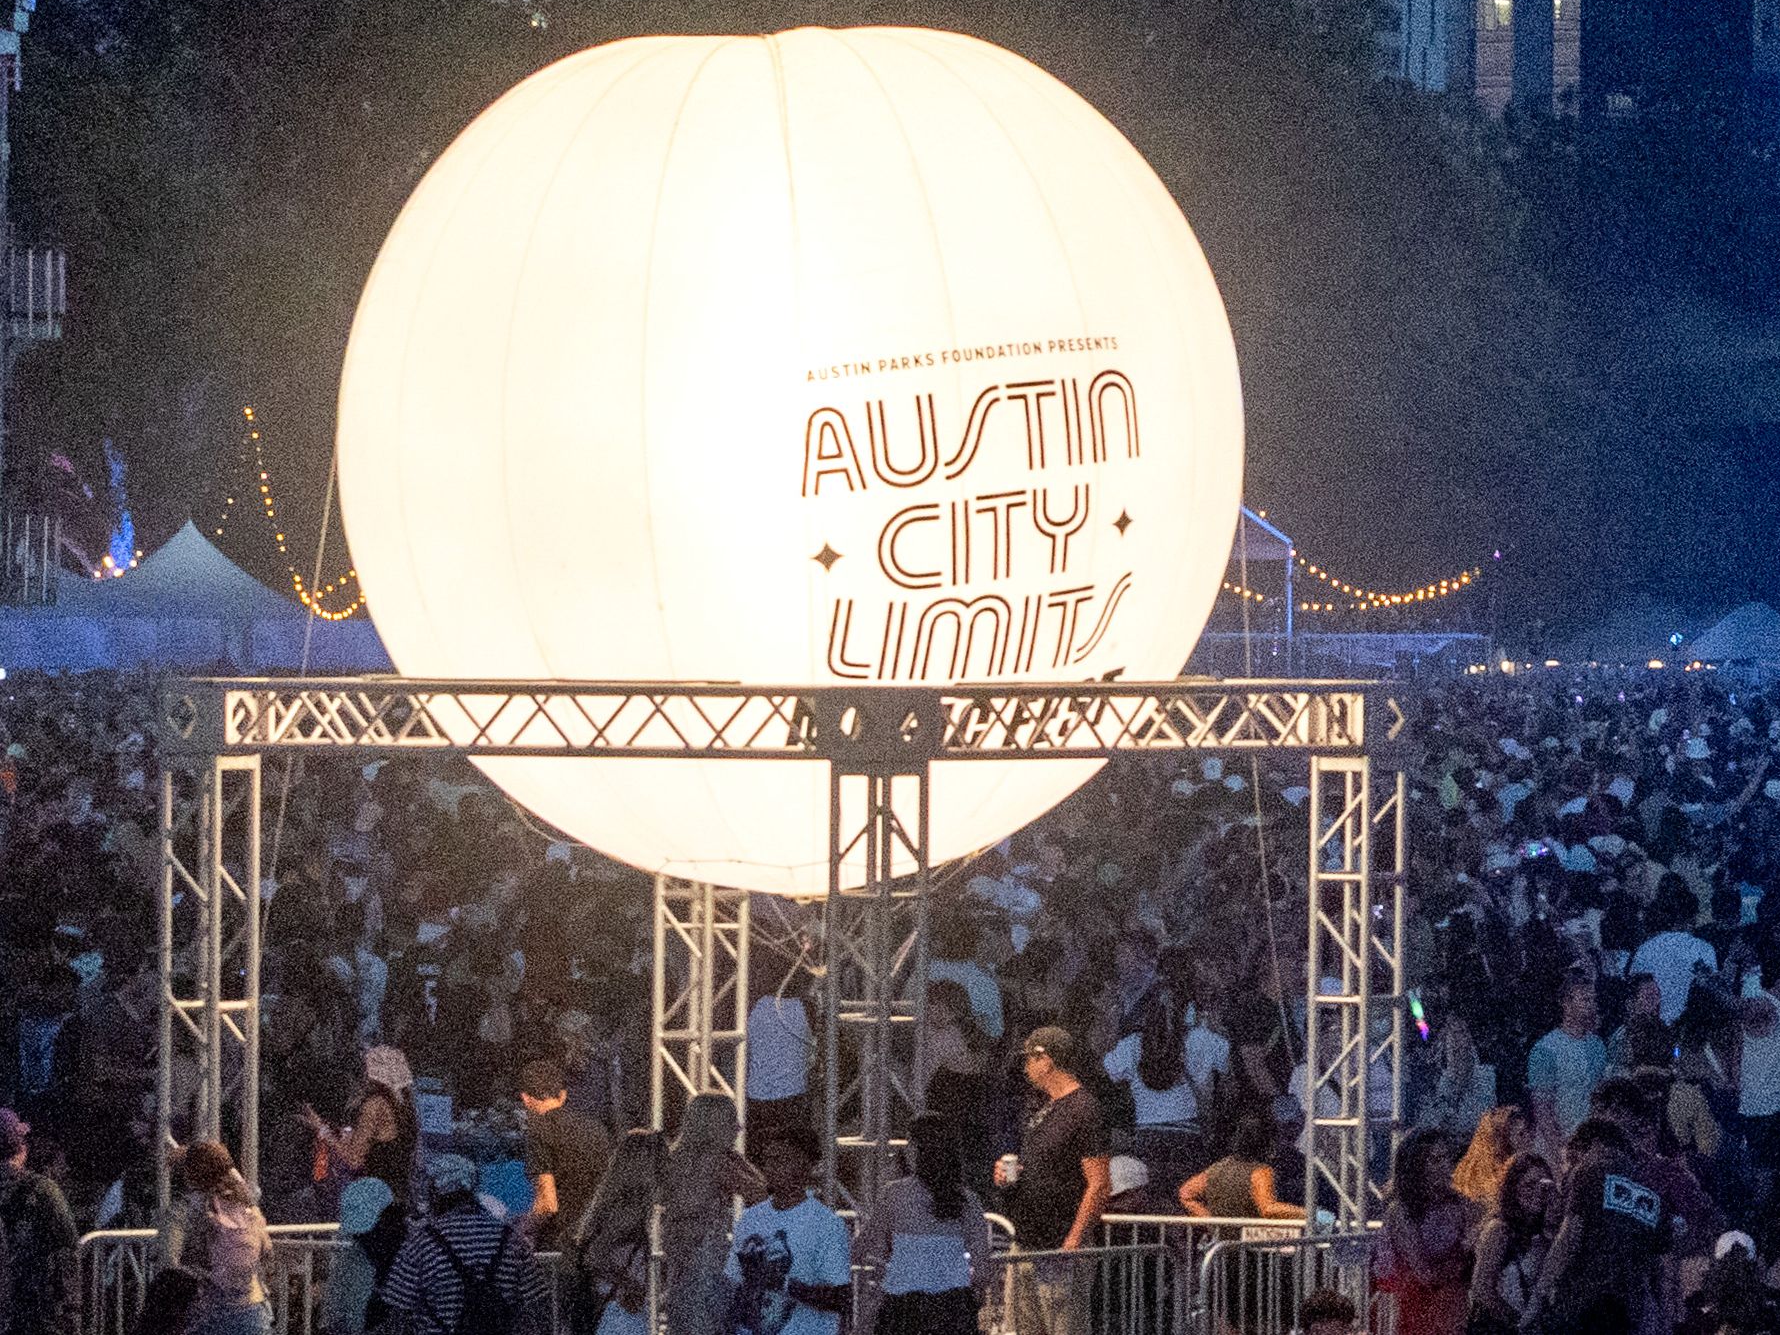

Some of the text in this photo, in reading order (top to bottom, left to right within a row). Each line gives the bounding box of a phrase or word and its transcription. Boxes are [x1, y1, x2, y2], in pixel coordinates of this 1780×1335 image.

[806, 336, 1119, 382] AUSTIN PARKS FOUNDATION PRESENTS
[801, 368, 1140, 498] AUSTIN
[877, 483, 1091, 590] CITY
[827, 571, 1133, 681] LIMITS
